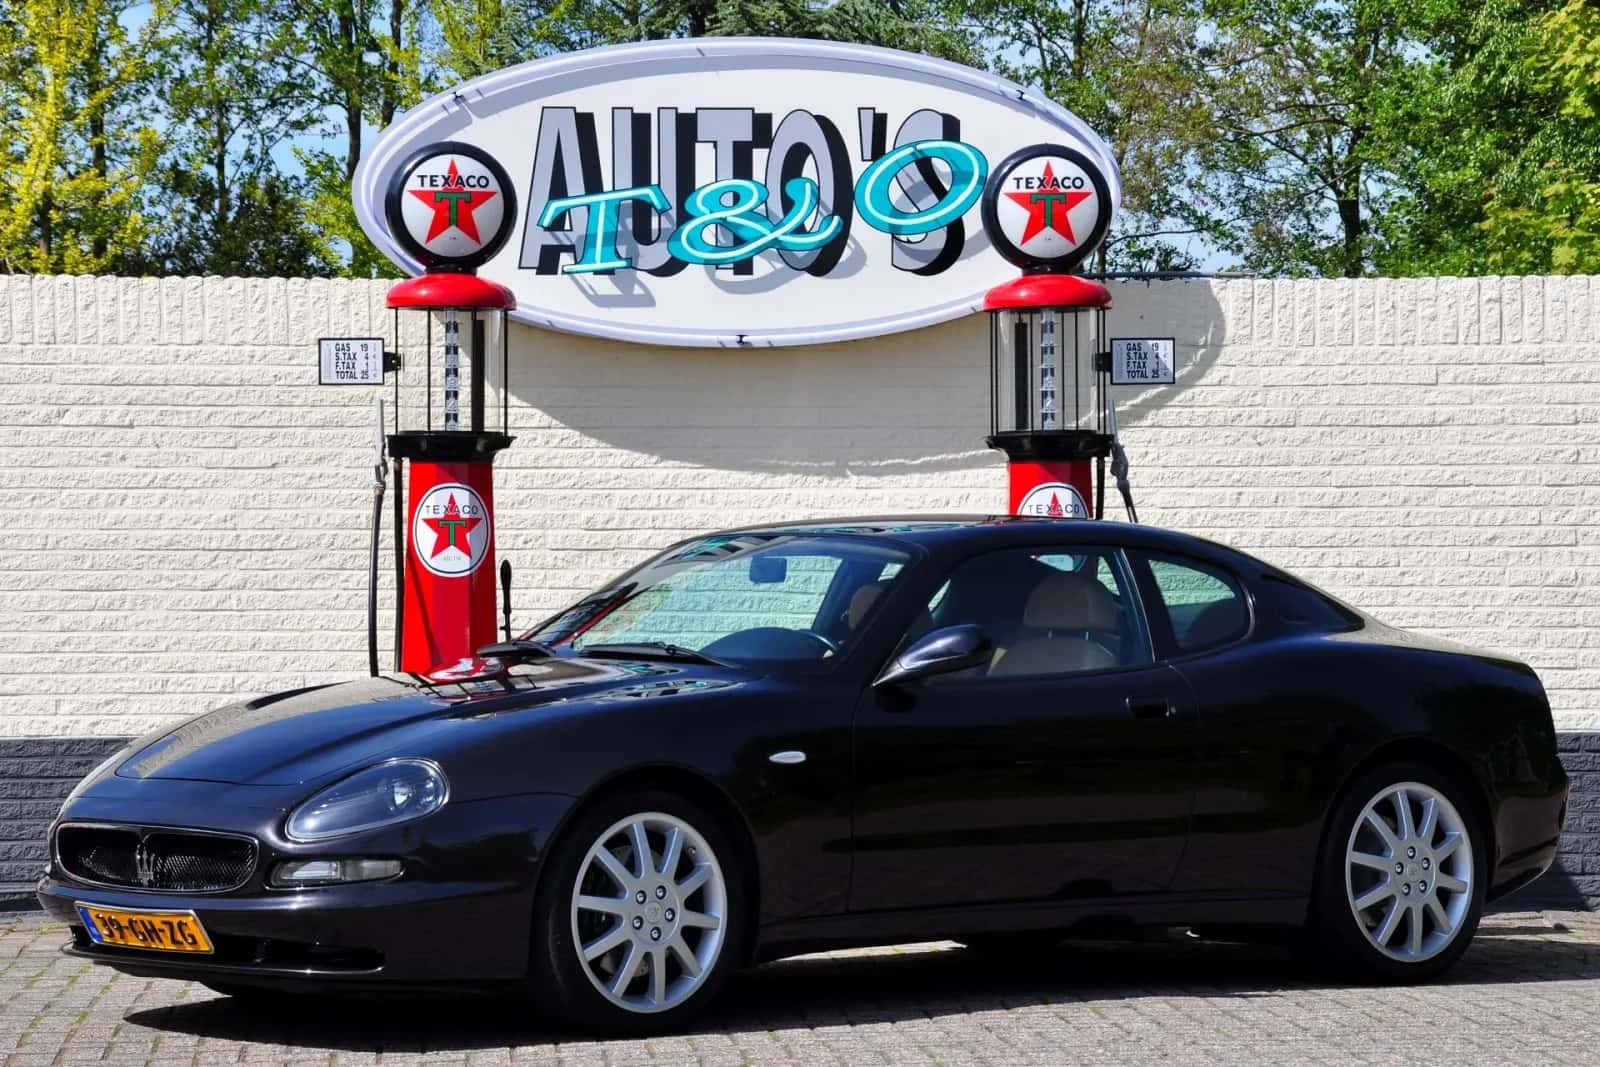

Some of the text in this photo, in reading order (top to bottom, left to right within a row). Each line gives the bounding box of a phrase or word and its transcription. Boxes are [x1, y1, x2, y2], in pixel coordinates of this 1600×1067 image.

[417, 175, 489, 188] TEXACO
[1013, 176, 1084, 190] TEXACO
[518, 106, 964, 276] AUTO'S
[434, 191, 471, 227] T
[1030, 192, 1067, 229] T
[335, 342, 369, 352] GAS 19
[1126, 342, 1159, 352] GAS 19
[335, 370, 369, 380] TOTAL 25
[1126, 369, 1149, 379] TOTAL
[425, 504, 479, 515] TEXACO
[1028, 503, 1080, 514] TEXACO
[439, 520, 467, 547] T
[95, 912, 198, 946] 39-GH-ZG
